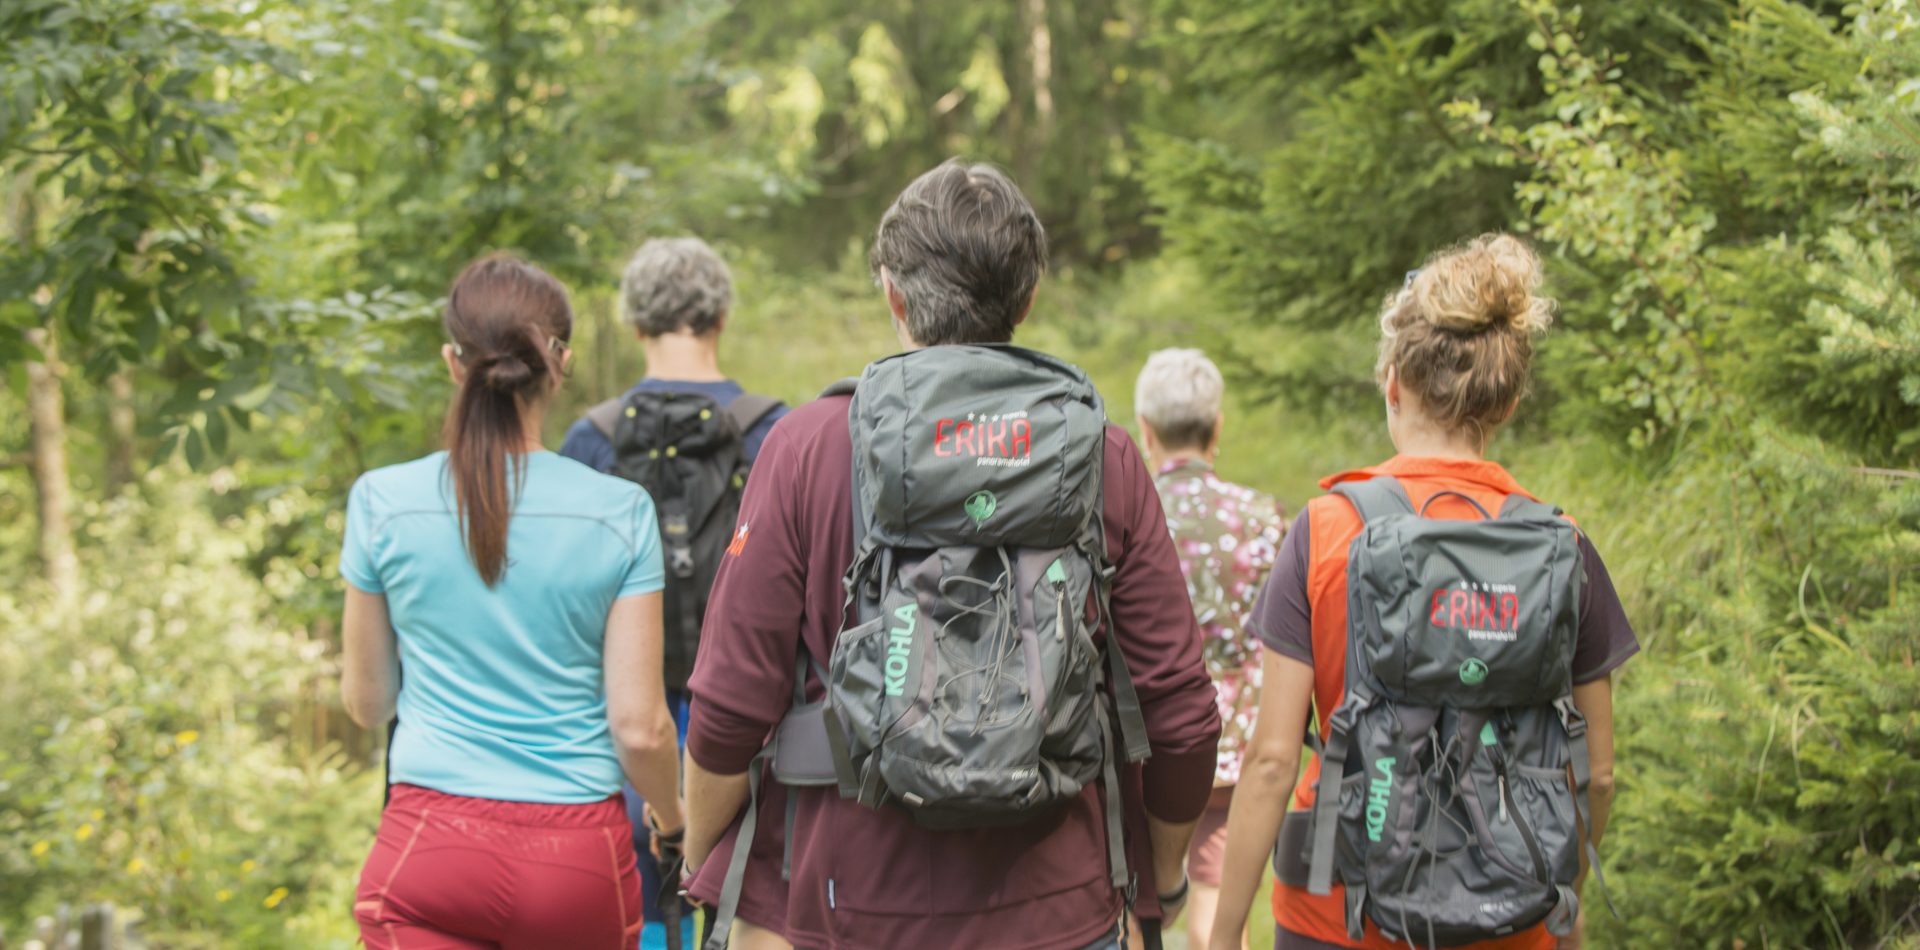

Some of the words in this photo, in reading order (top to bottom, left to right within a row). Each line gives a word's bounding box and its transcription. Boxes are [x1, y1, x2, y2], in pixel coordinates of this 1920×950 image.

[934, 418, 1031, 458] ERIKA
[1430, 588, 1518, 631] ERIKA
[884, 602, 919, 696] KOHLA
[1365, 756, 1397, 842] KOHLA
